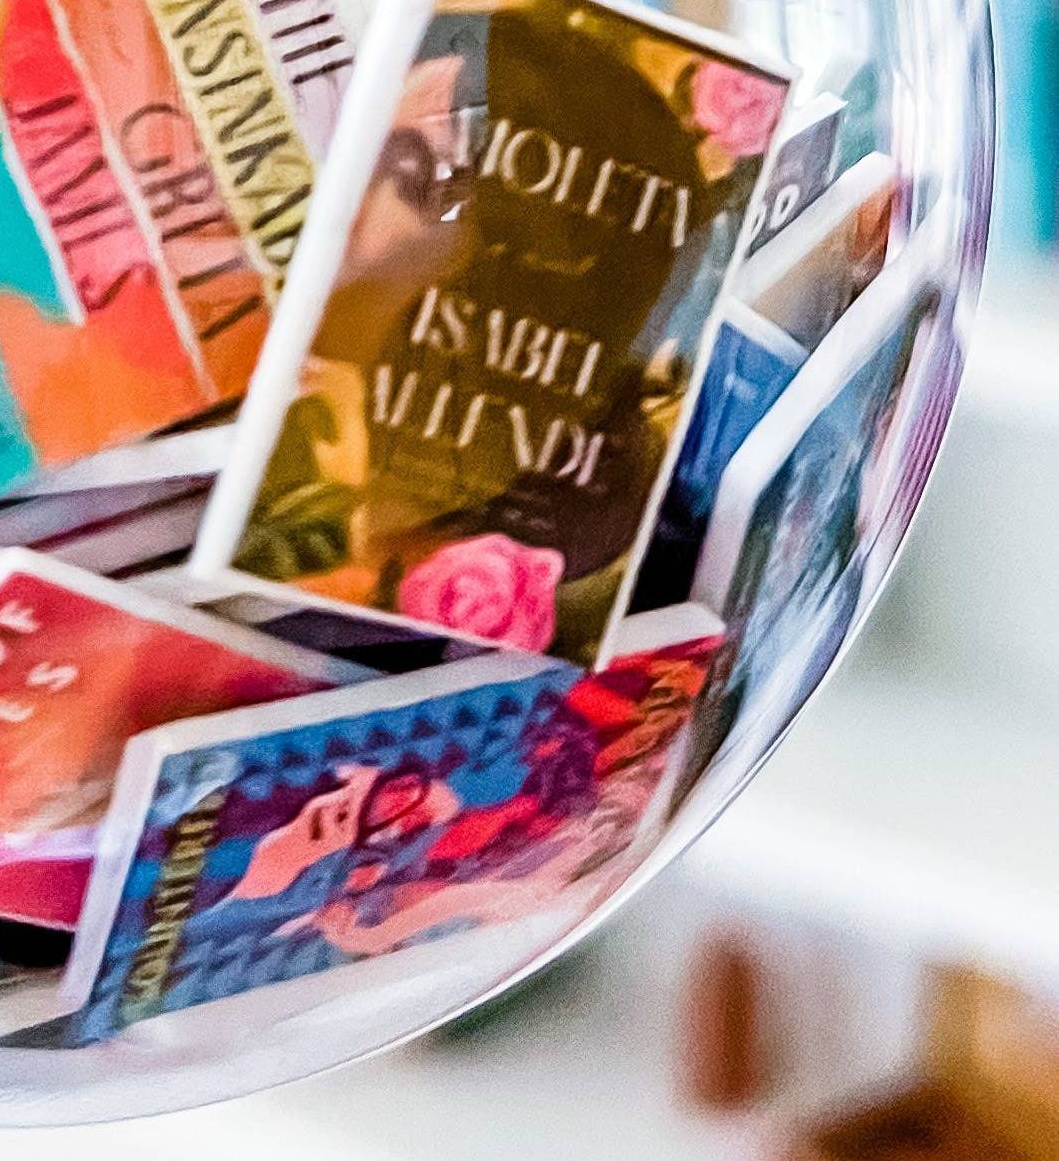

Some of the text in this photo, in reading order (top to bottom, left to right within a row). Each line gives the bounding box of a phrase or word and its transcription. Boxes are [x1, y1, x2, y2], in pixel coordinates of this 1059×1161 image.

[5, 94, 158, 313] JAMES
[120, 102, 261, 340] GRETA
[447, 107, 691, 247] VIOLETA
[410, 286, 603, 397] ISABEL
[373, 364, 606, 487] ALLENDE
